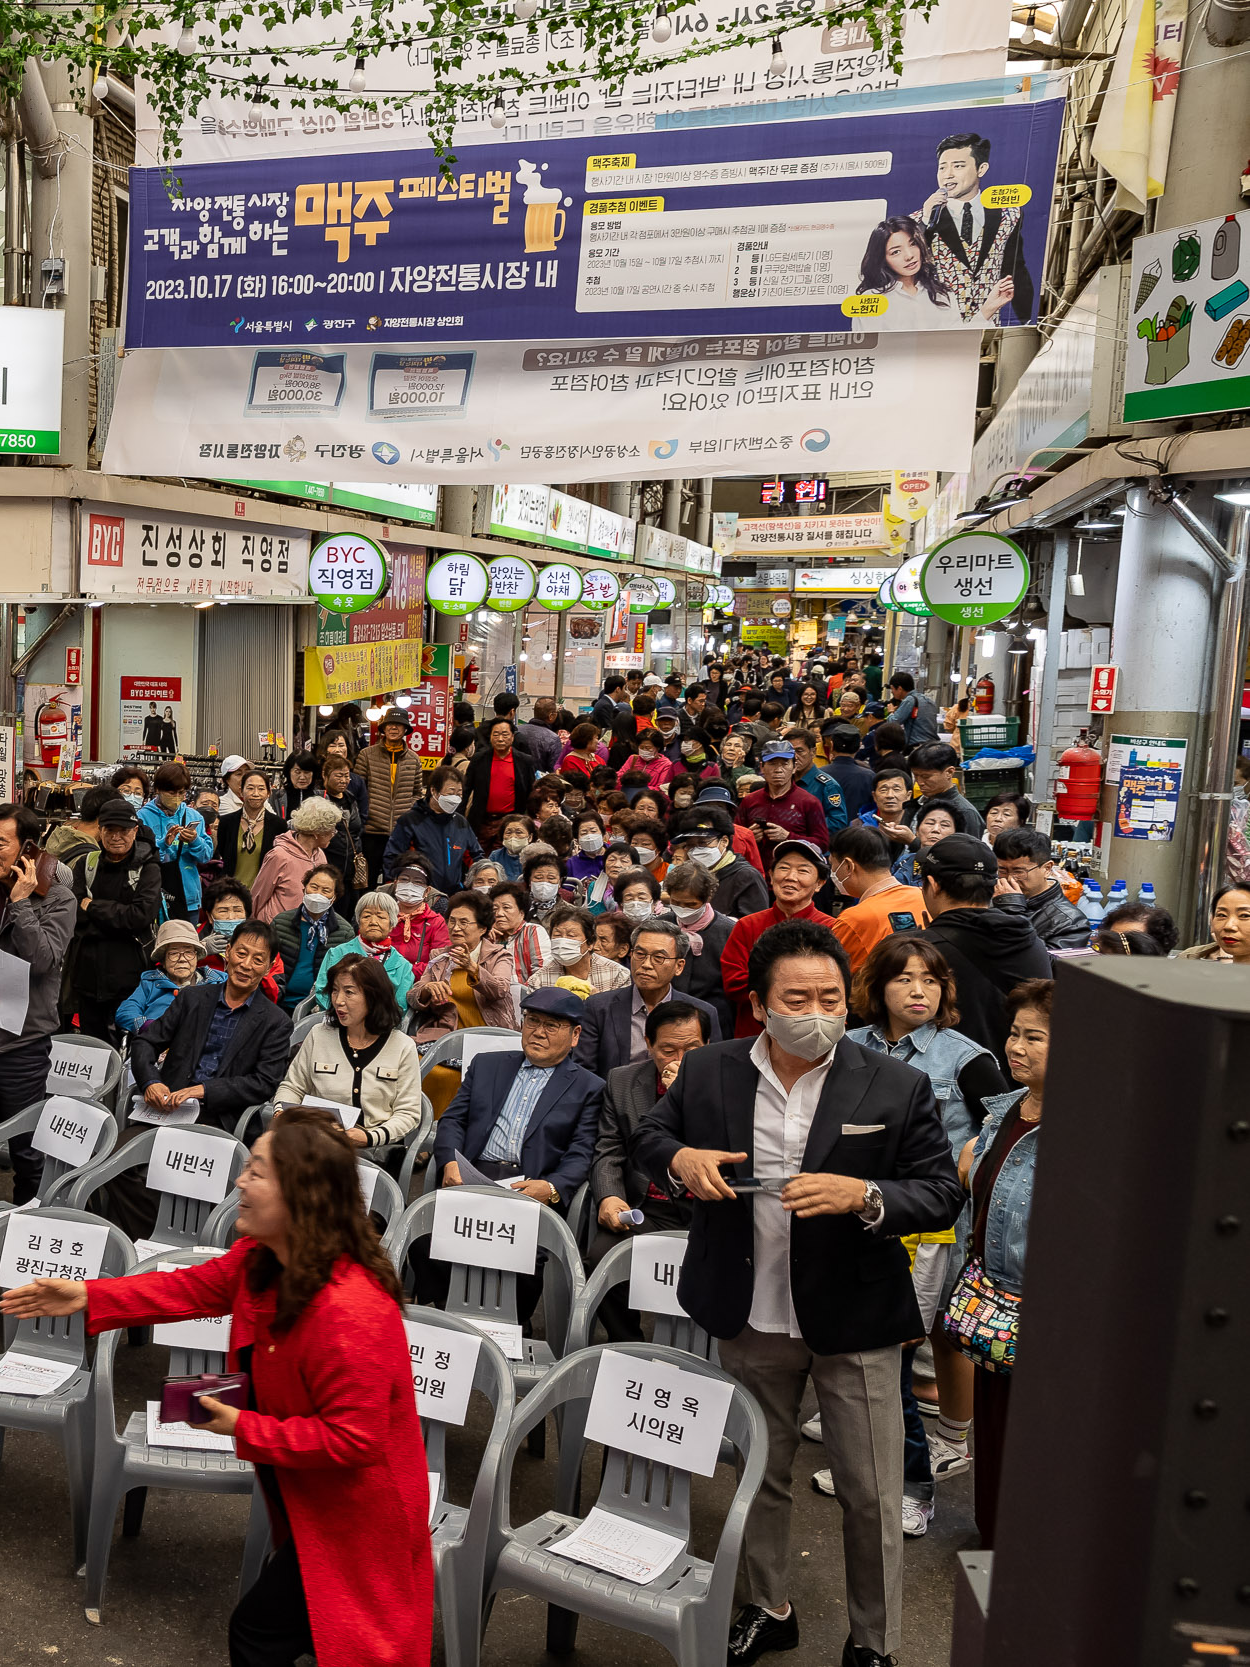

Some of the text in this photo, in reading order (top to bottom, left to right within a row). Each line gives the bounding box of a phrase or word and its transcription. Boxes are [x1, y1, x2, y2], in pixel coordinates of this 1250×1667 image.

[592, 156, 631, 170] 맥주축제
[780, 163, 799, 176] 무료
[800, 162, 818, 175] 증정
[589, 199, 658, 214] 경품추첨 이벤트
[990, 194, 1020, 205] 박현빈
[171, 192, 289, 231] 자양 전통 시장
[294, 170, 512, 263] 맥주 페스티벌
[590, 220, 622, 231] 응모 방법
[143, 220, 289, 260] 고객과 함께 하는
[736, 241, 769, 252] 경품안내
[588, 247, 620, 258] 응모 기간
[146, 274, 232, 300] 2023.10.17
[271, 270, 375, 297] 16:00~20:00
[389, 260, 530, 295] 자양전통시장
[535, 259, 558, 288] 내
[585, 276, 602, 286] 추첨
[732, 288, 756, 299] 행운상
[850, 303, 879, 314] 노현지
[244, 319, 293, 333] 서울특별시
[322, 317, 356, 330] 광진구
[383, 315, 464, 329] 자양전통시장 상인회
[902, 482, 927, 490] OPEN
[742, 517, 883, 532] 고객선(황색선)을 지키지 못하는 당신이!
[91, 523, 121, 562] BYC
[750, 528, 872, 543] 자양전통시장 질서를 해칩니다
[141, 524, 291, 574] 진성상회 직영점
[327, 546, 365, 564] BYC
[447, 562, 470, 577] 하림
[935, 553, 1015, 574] 우리마트
[317, 568, 374, 590] 직영점
[490, 566, 526, 580] 맛있는
[547, 571, 571, 584] 신선
[448, 577, 467, 596] 닭
[494, 580, 519, 595] 반찬
[546, 585, 570, 597] 야채
[953, 576, 993, 597] 생선
[959, 606, 984, 618] 생선
[130, 689, 168, 698] BYC 보디히트
[428, 734, 444, 752] 닭
[53, 1060, 93, 1081] 내빈석
[49, 1114, 89, 1145] 내빈석
[165, 1150, 215, 1178] 내빈석
[453, 1215, 516, 1245] 내빈석
[15, 1256, 88, 1282] 광진구청장
[626, 1412, 685, 1445] 시의원
